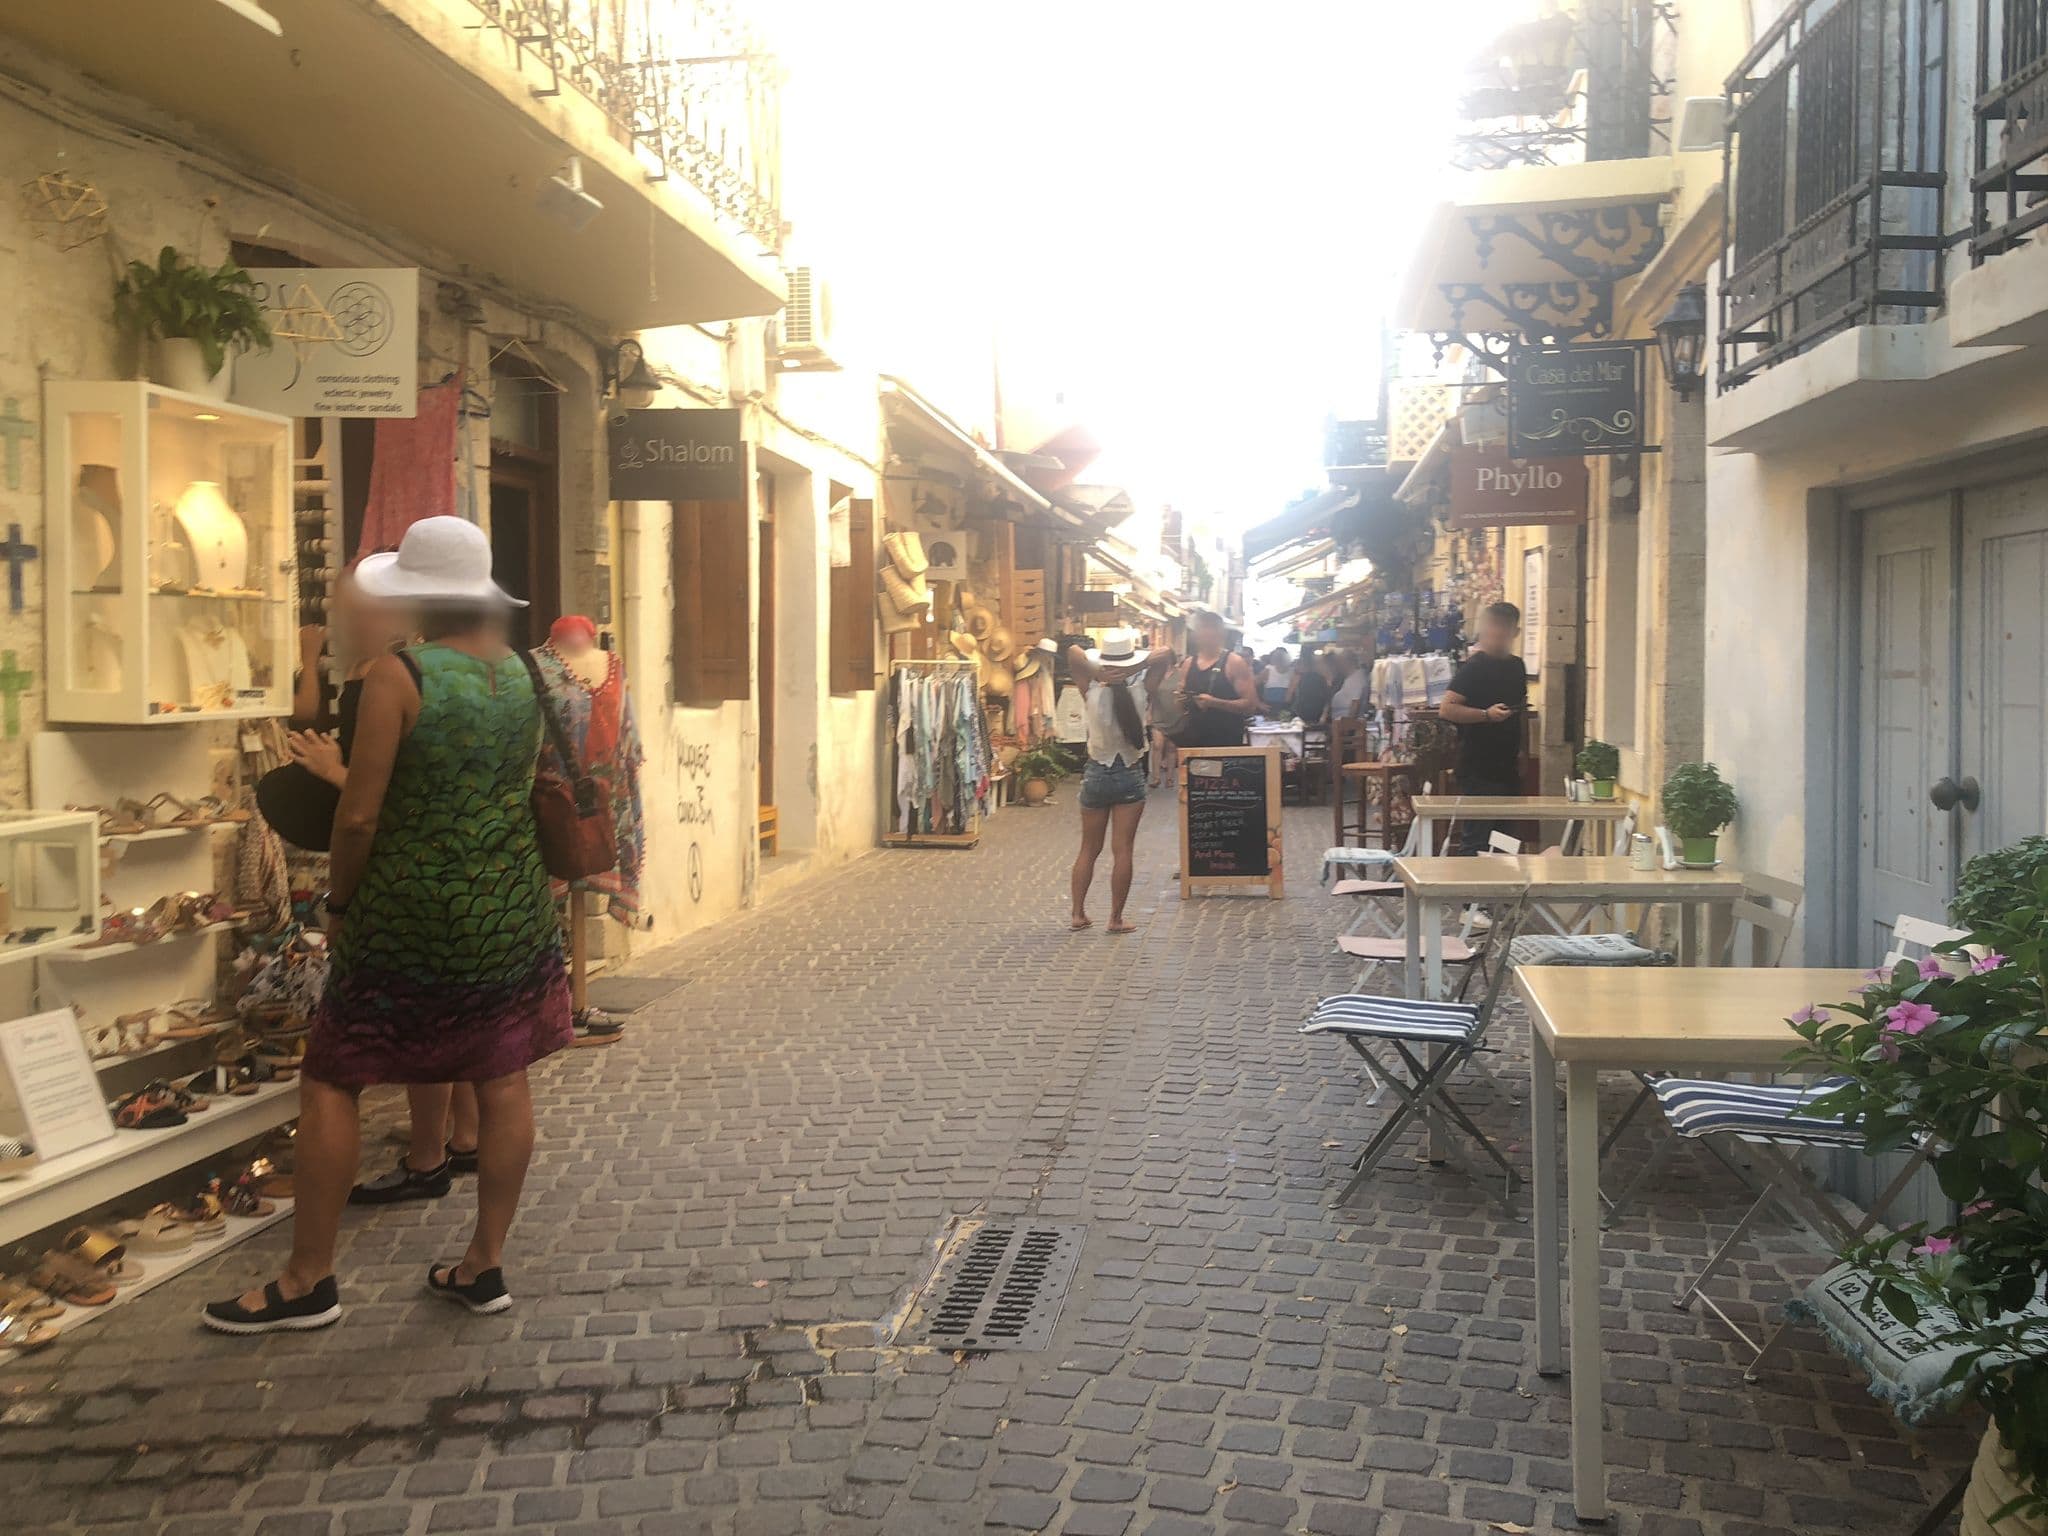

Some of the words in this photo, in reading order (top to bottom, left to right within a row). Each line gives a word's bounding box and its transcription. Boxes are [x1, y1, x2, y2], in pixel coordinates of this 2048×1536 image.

[316, 375, 360, 384] conscious
[362, 374, 401, 386] clothing
[1526, 364, 1566, 385] Casa
[1569, 362, 1595, 383] del
[1597, 360, 1626, 382] Mar
[368, 402, 403, 413] sandals
[645, 437, 734, 463] Shalom
[1475, 464, 1563, 496] Phyllo
